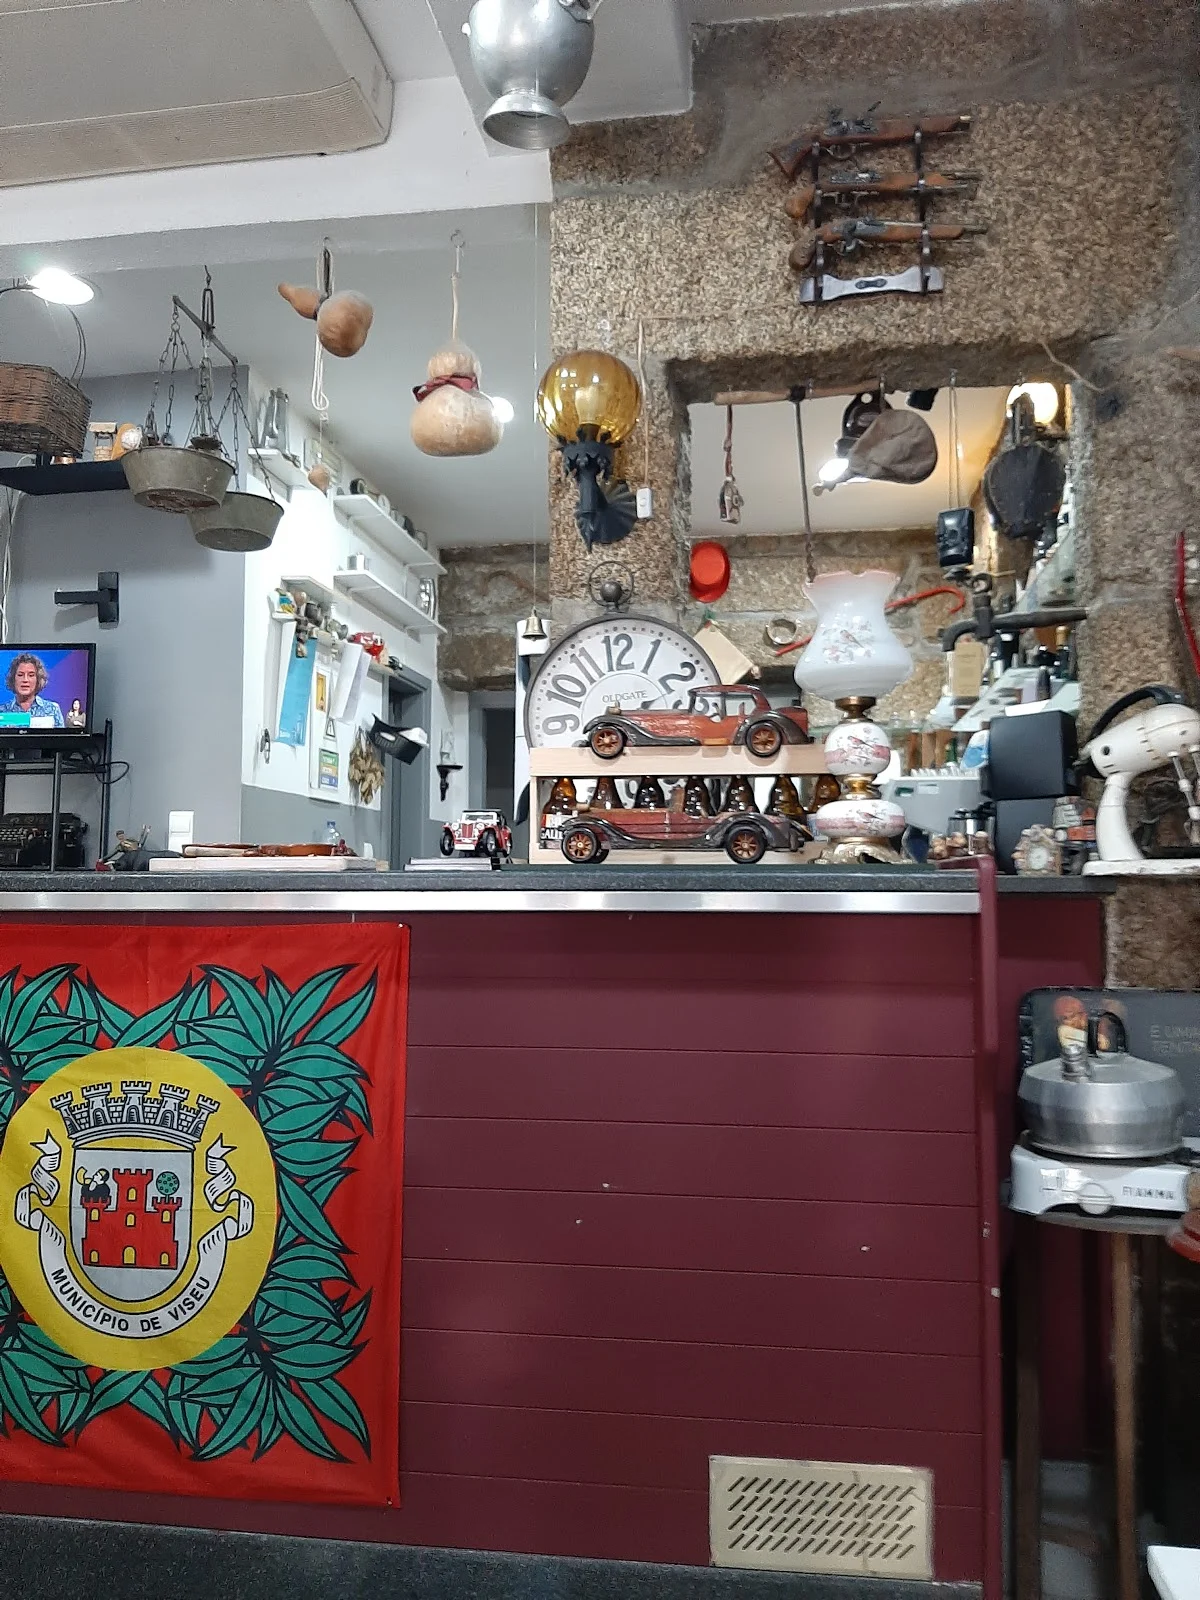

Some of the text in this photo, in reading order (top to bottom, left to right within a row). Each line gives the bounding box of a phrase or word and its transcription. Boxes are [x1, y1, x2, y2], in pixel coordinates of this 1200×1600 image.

[569, 646, 606, 686] 11
[601, 633, 635, 672] 12
[641, 639, 662, 675] 1
[545, 674, 587, 709] 10
[658, 661, 697, 695] 2
[602, 689, 648, 703] OLDGATE
[541, 713, 580, 736] 9
[51, 1268, 210, 1333] MUNICÍPIO DE VISEU
